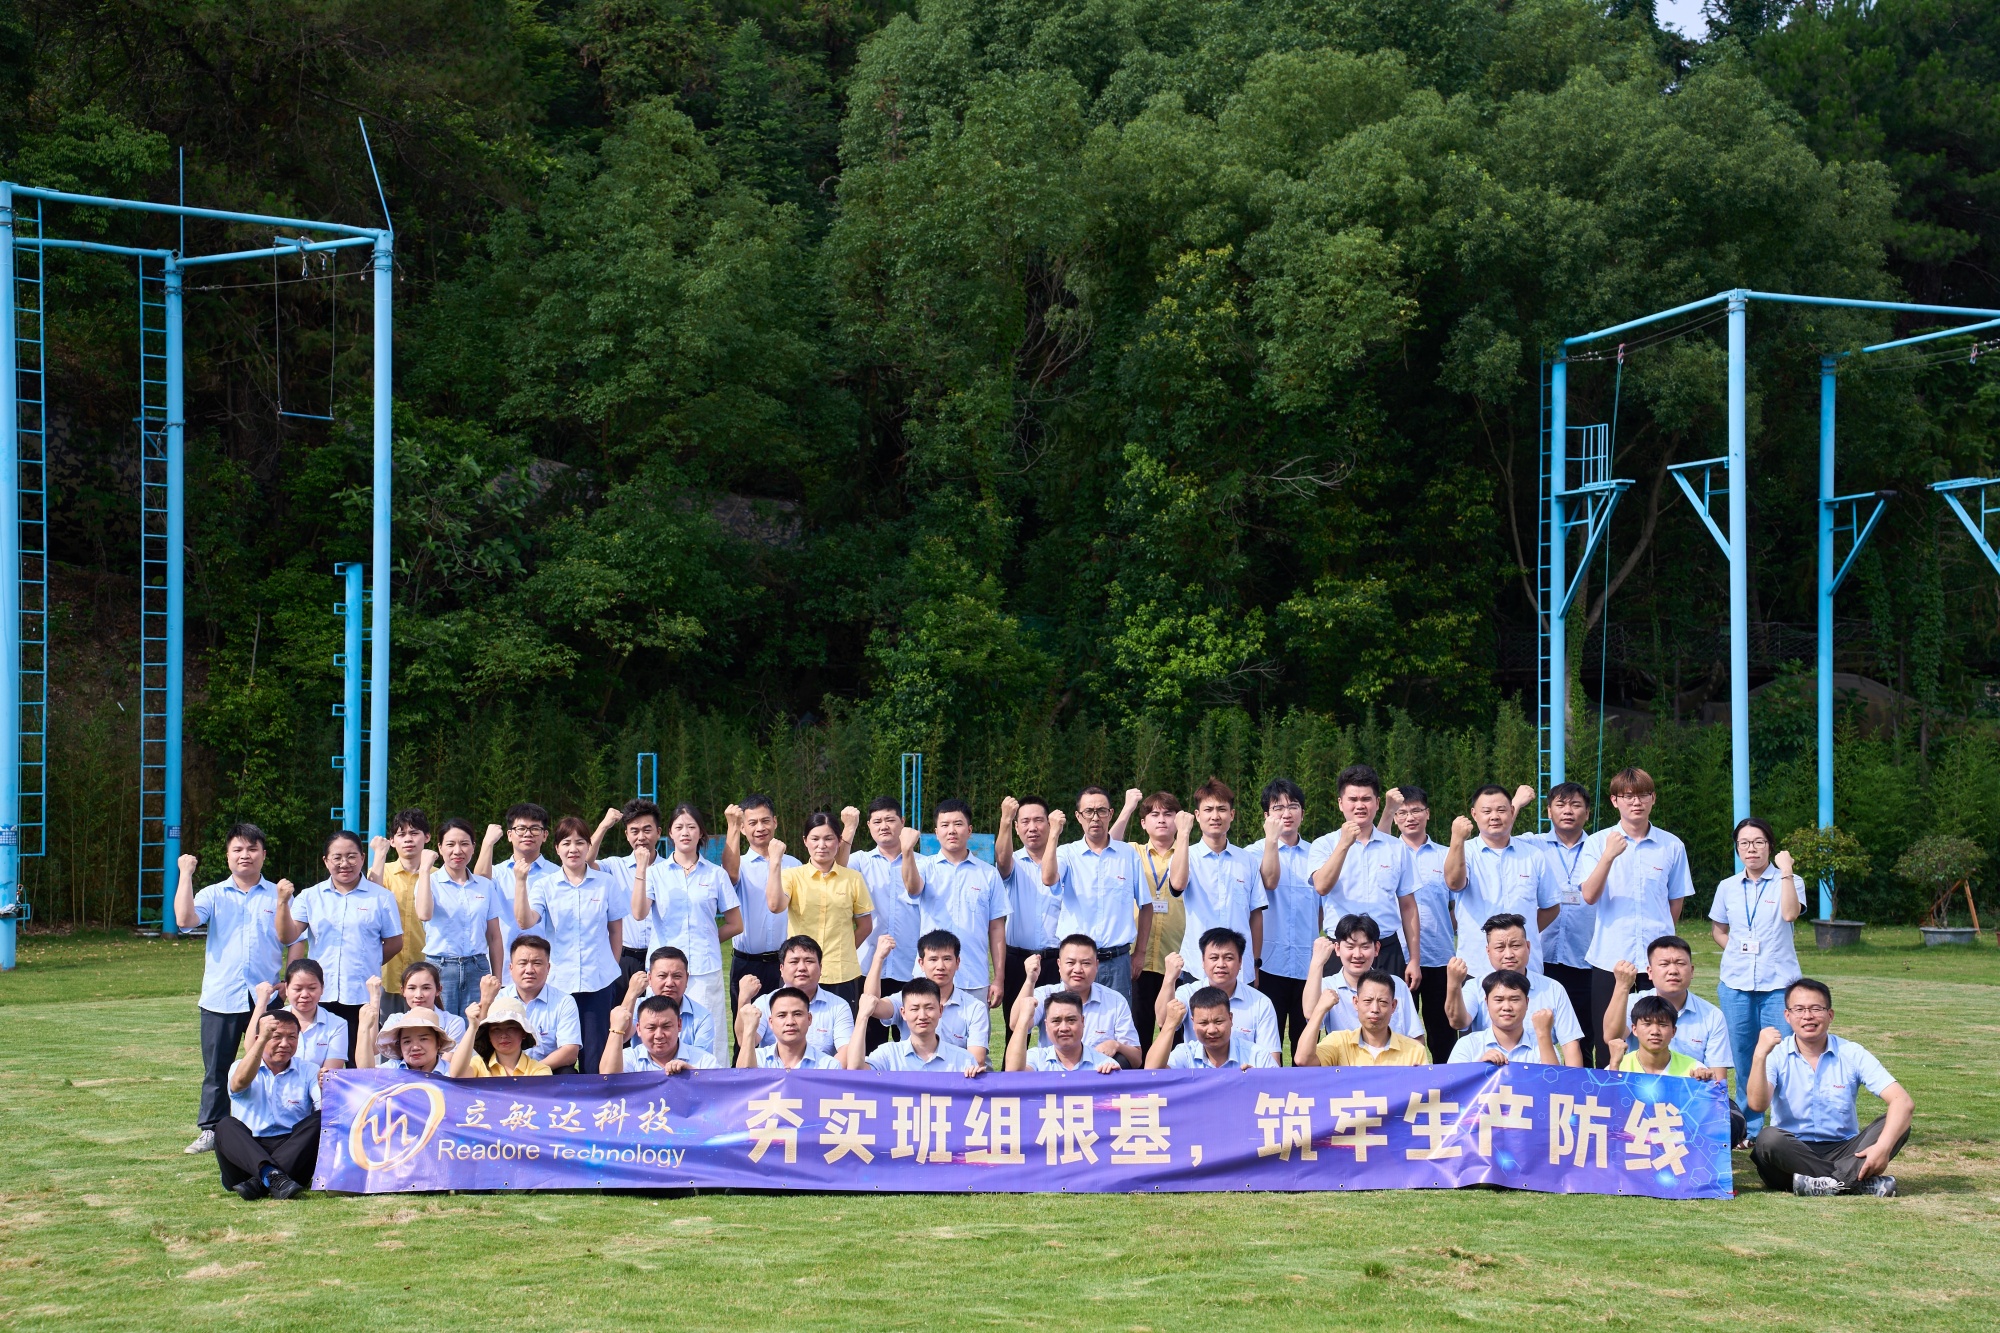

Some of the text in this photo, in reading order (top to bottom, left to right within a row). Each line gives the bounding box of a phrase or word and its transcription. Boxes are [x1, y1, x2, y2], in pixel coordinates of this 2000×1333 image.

[456, 1097, 674, 1135] 立敏达科技
[1253, 1085, 1690, 1177] 筑牢生产防线
[438, 1139, 686, 1169] Readore Technology
